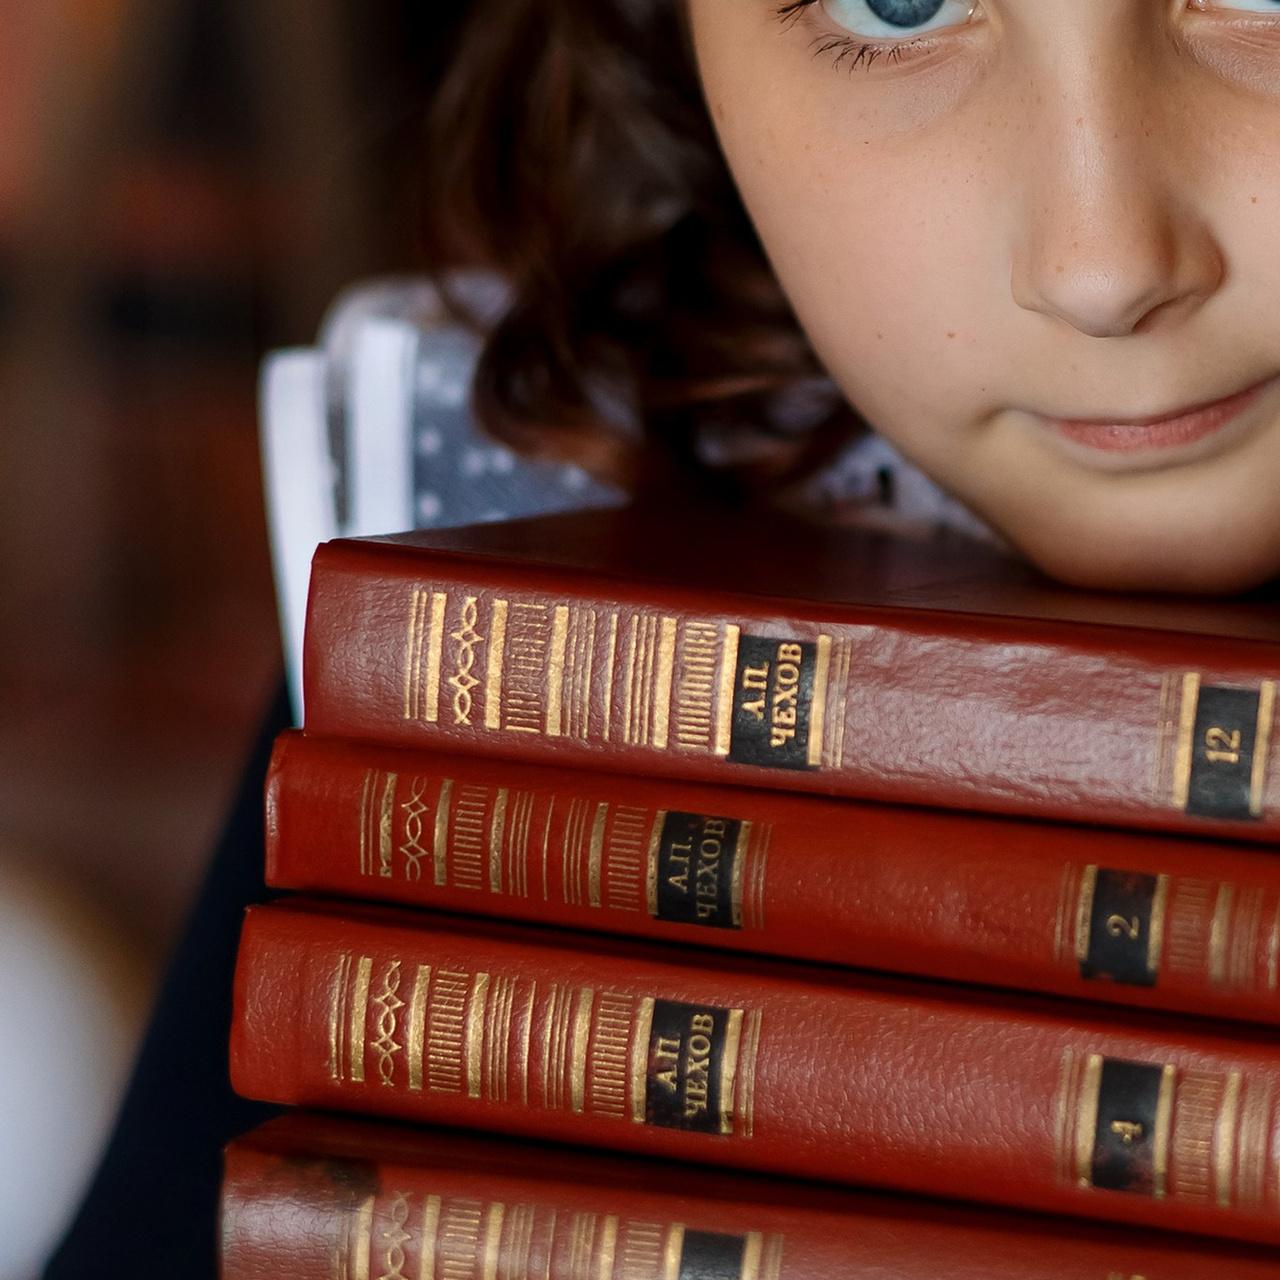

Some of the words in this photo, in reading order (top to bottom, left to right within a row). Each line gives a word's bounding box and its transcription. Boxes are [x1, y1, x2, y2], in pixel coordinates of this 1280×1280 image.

[770, 643, 802, 748] ЧЕХОВ
[1205, 727, 1241, 764] 12
[697, 820, 725, 917] ЧЕХОВ
[1106, 914, 1139, 939] 2
[684, 1014, 714, 1117] ЧЕХОВ
[1111, 1120, 1142, 1144] 4
